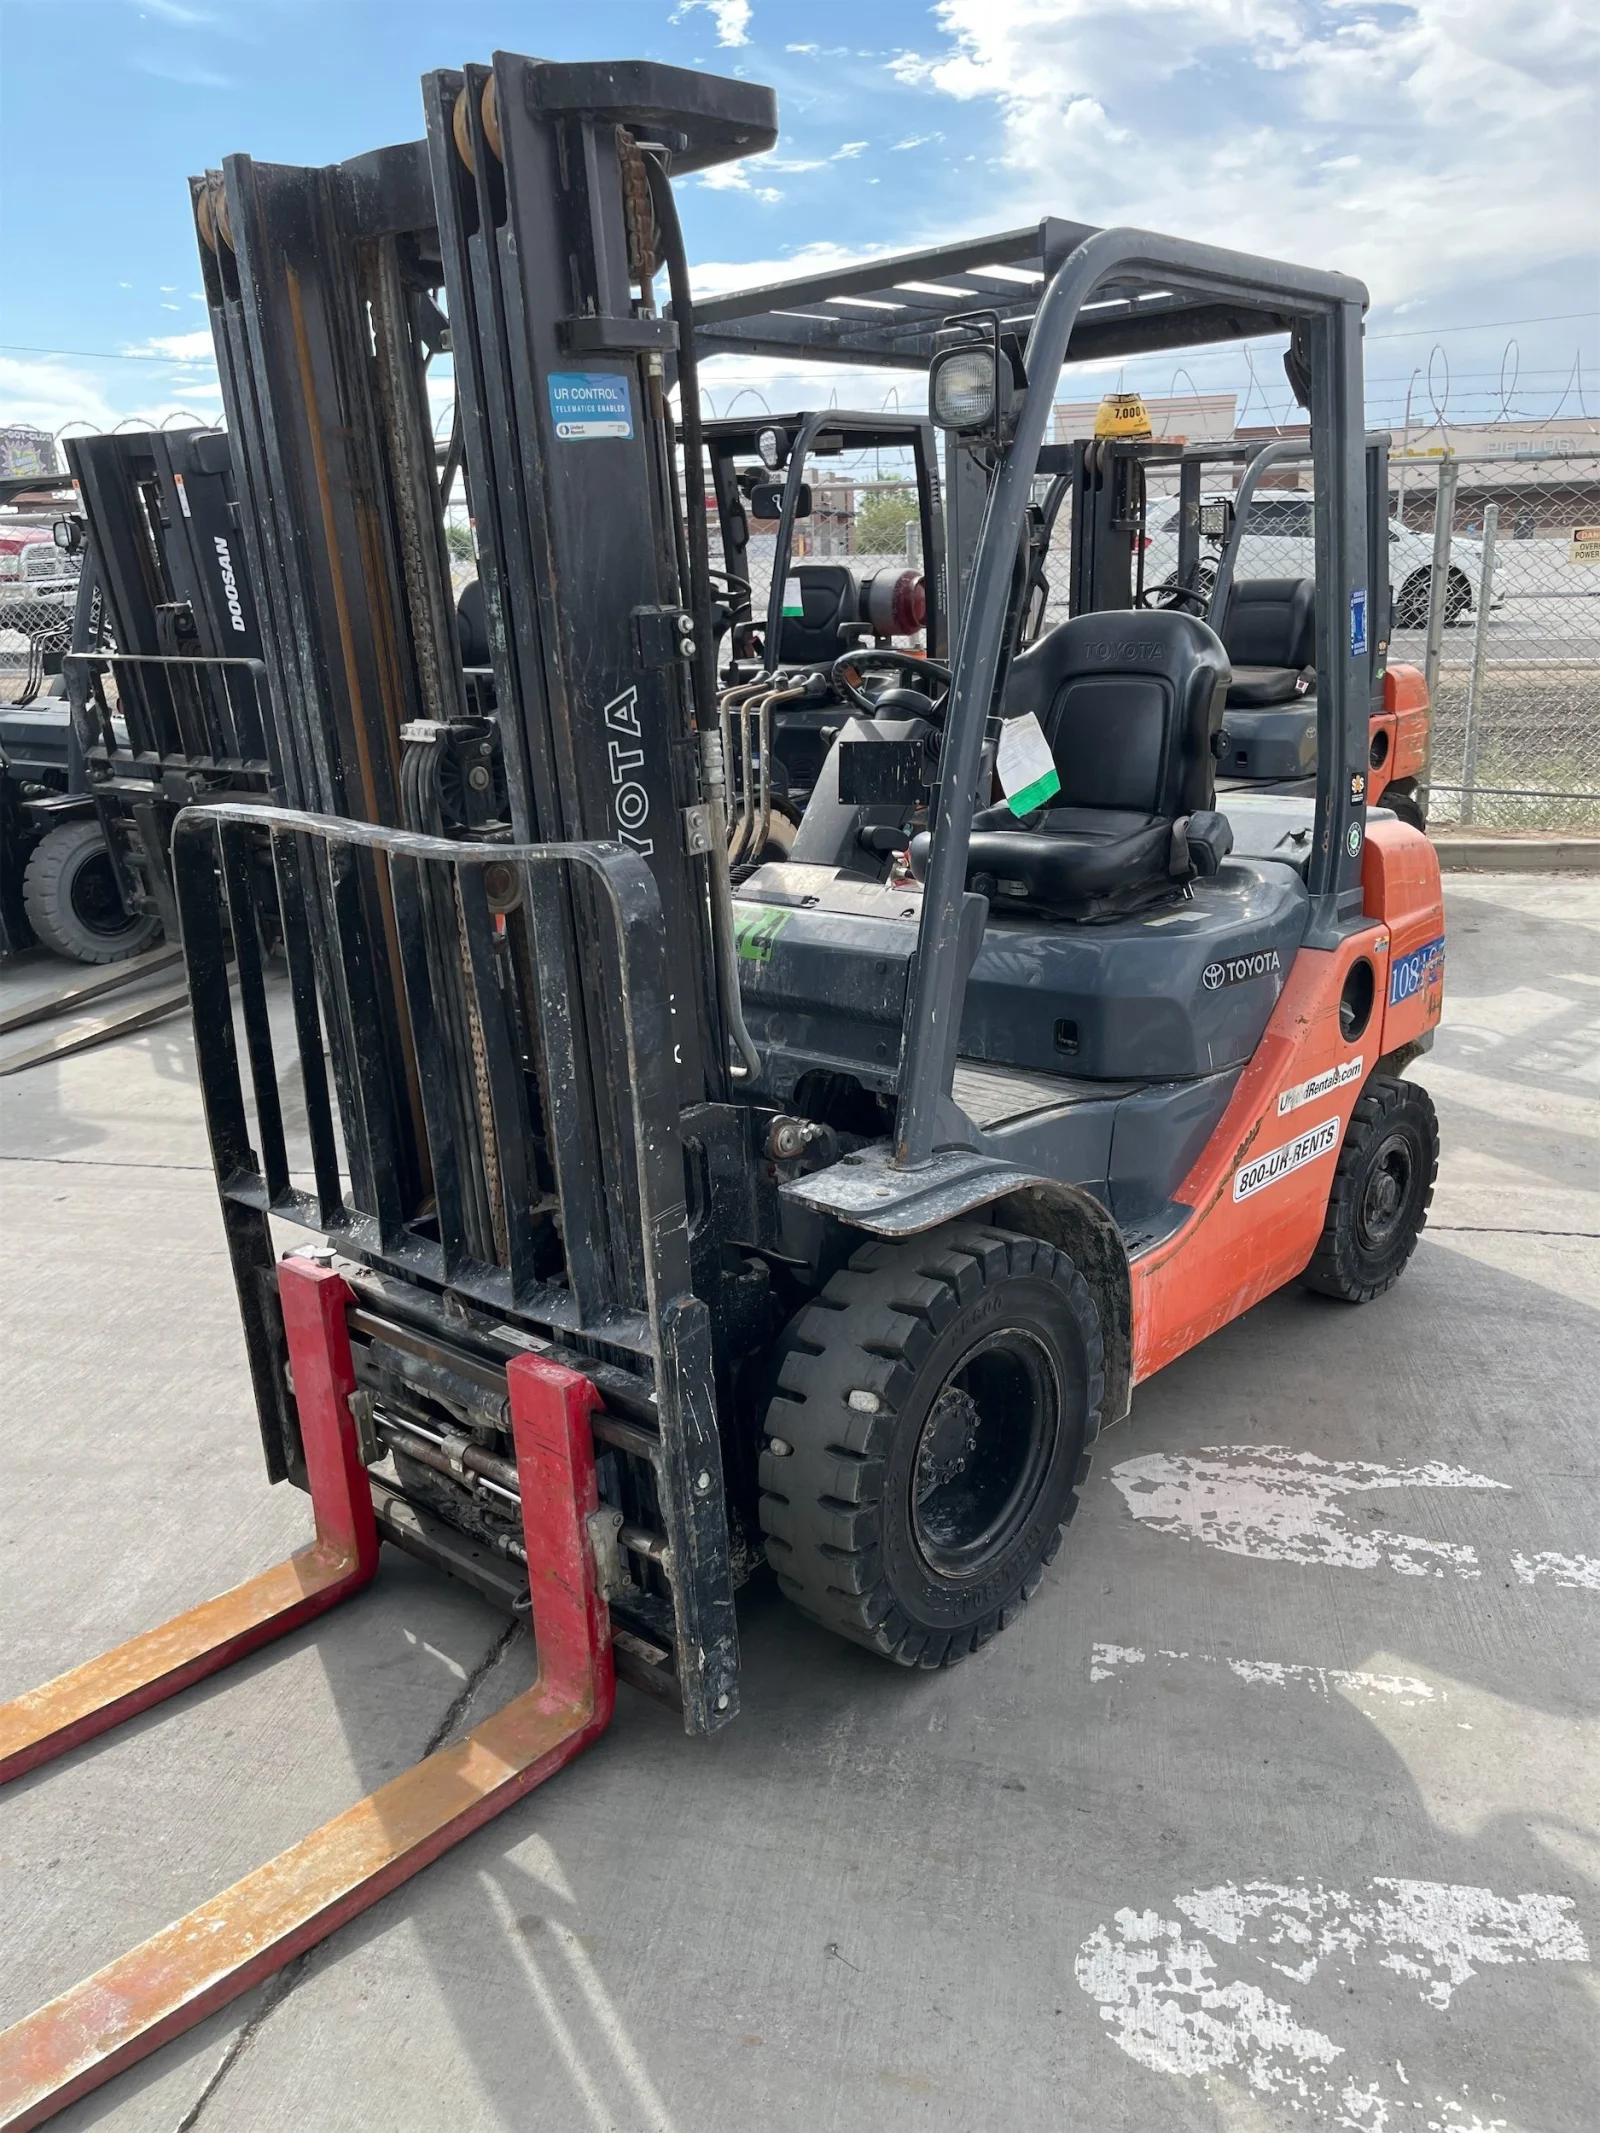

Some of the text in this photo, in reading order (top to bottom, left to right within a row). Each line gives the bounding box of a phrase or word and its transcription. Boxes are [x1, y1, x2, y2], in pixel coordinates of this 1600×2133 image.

[554, 388, 618, 400] UR CONTROL
[556, 404, 626, 413] TELEMATICS ENABLED
[1114, 406, 1141, 420] 7,000
[1575, 550, 1599, 559] POWER
[214, 536, 245, 631] DOOSAN
[1084, 641, 1164, 661] TOYOTA
[1226, 951, 1280, 981] TOYOTA
[1239, 1125, 1335, 1193] 800-UR-RENTS
